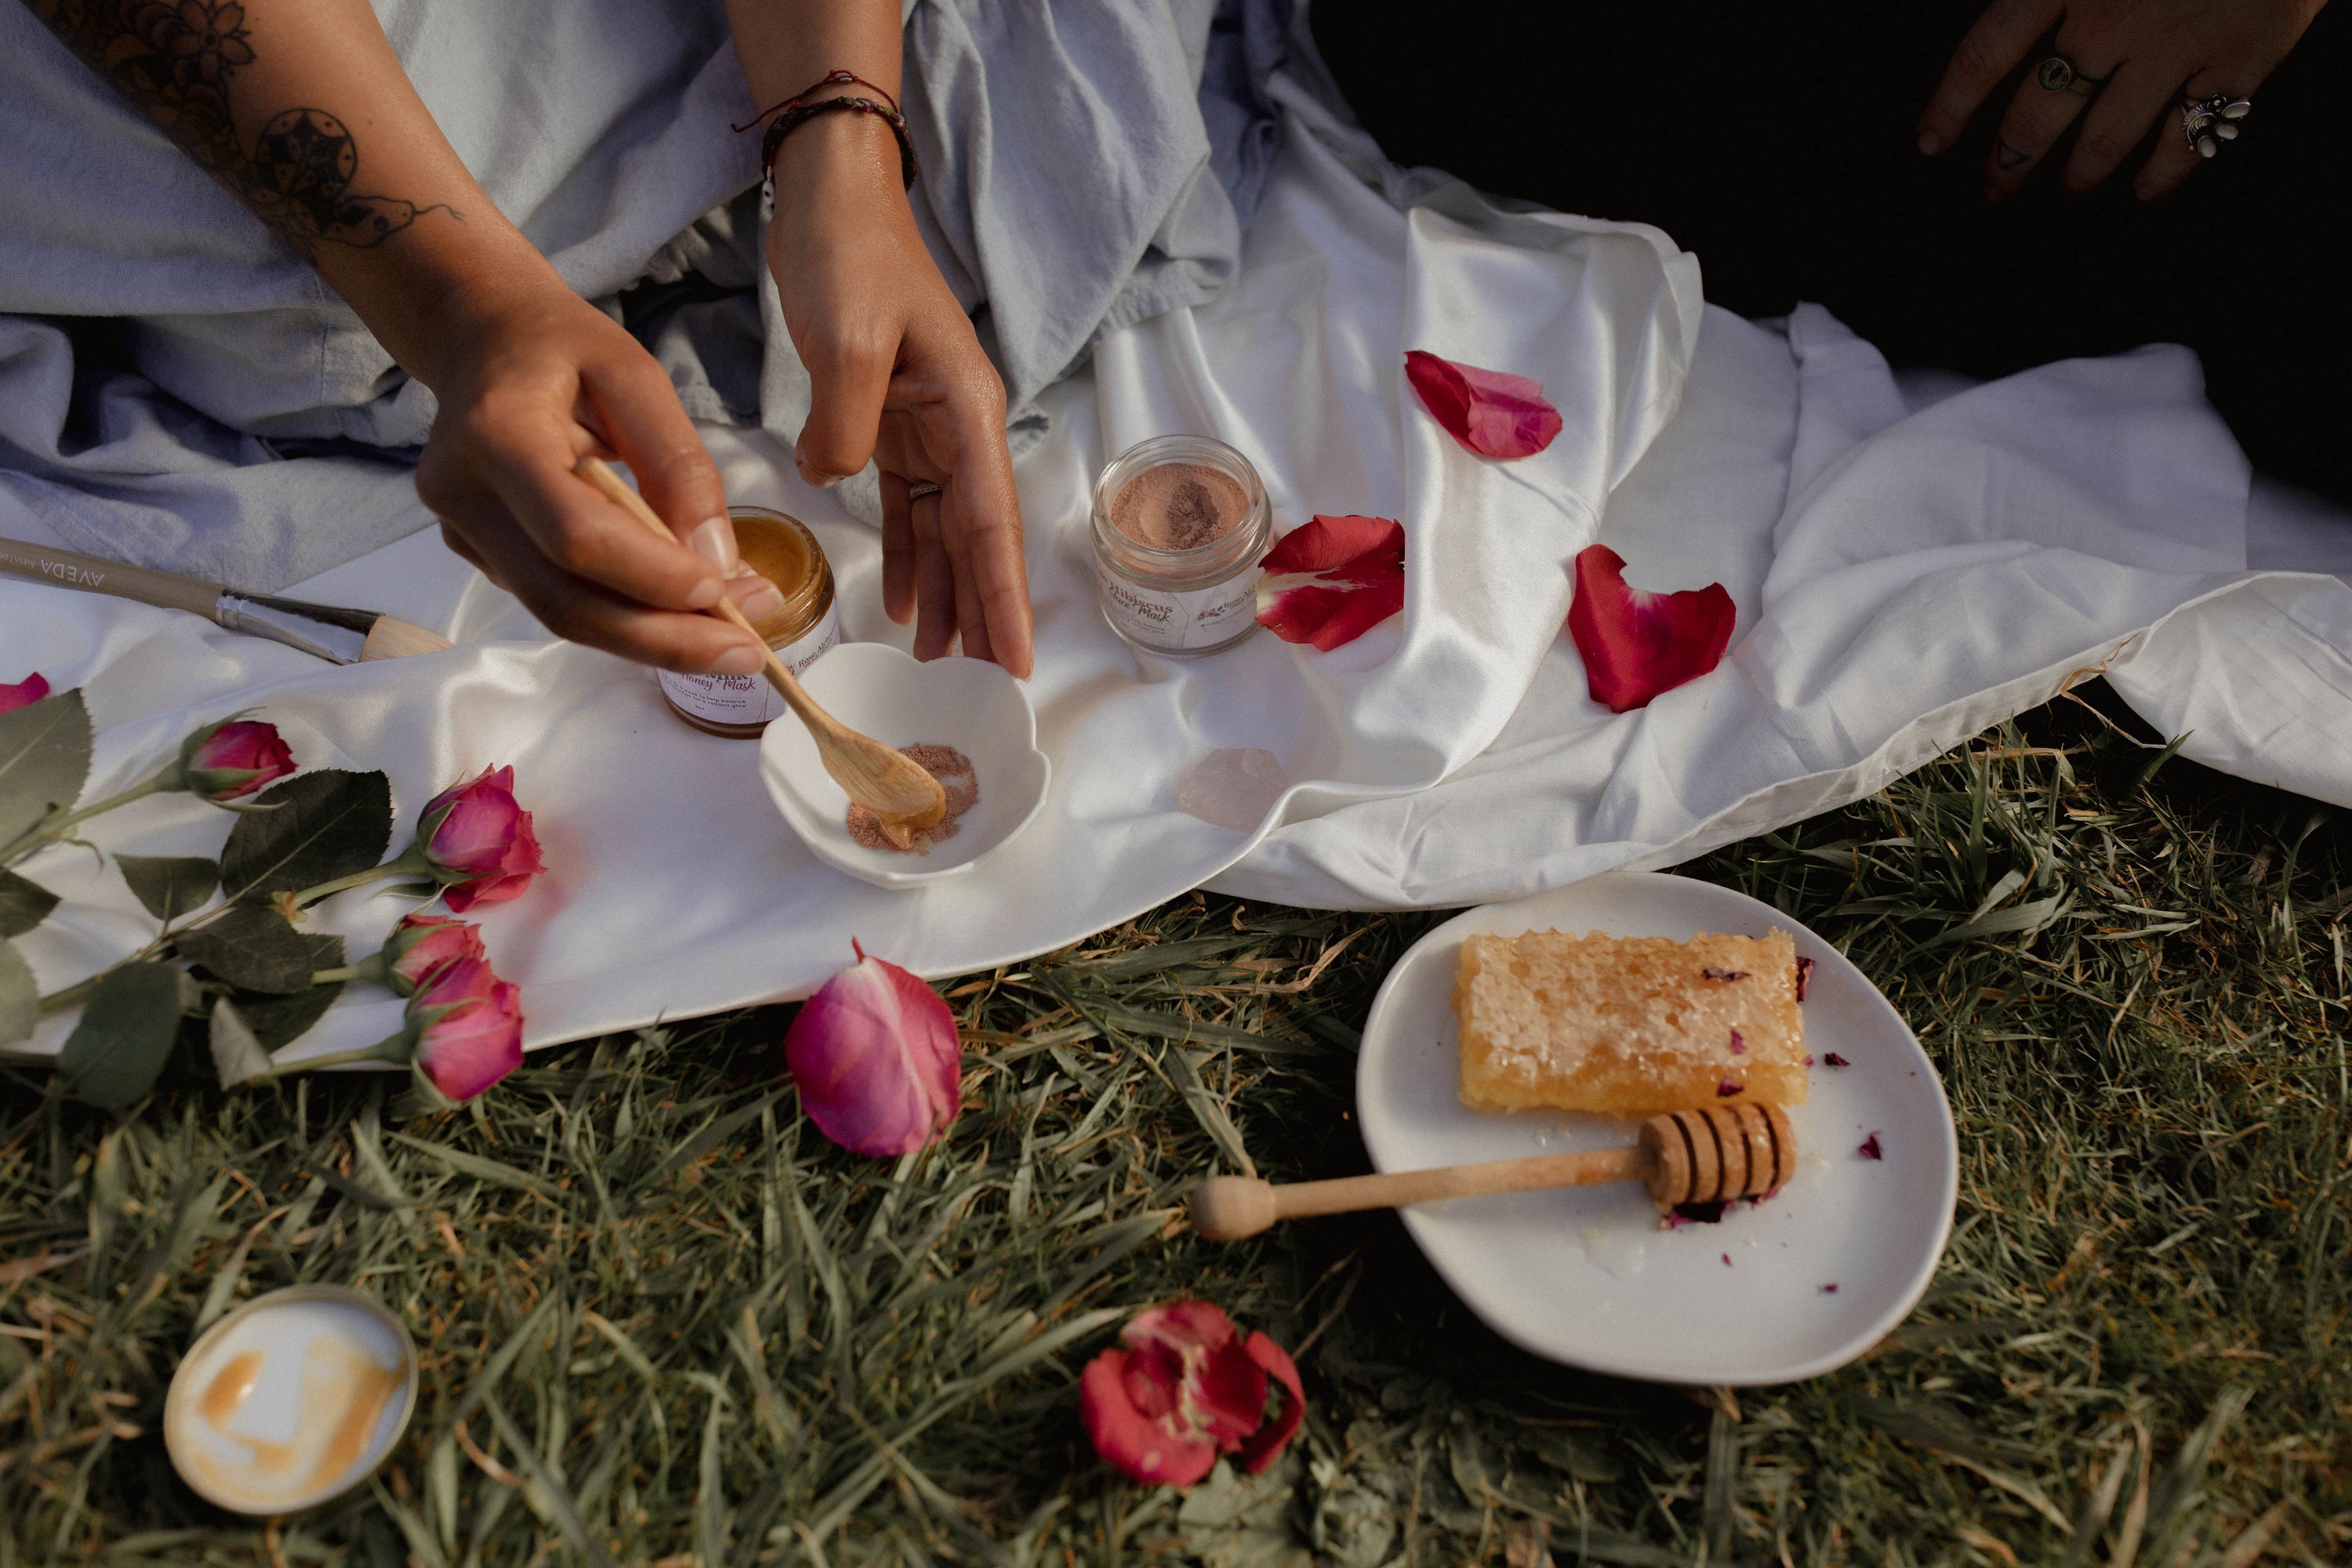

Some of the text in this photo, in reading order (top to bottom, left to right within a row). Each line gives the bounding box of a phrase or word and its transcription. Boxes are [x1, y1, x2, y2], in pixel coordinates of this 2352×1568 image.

[40, 559, 105, 587] AVEDA
[1109, 581, 1174, 613] Hibiscus
[1132, 604, 1171, 622] Mask
[798, 652, 816, 667] Rose
[716, 677, 756, 691] Mask
